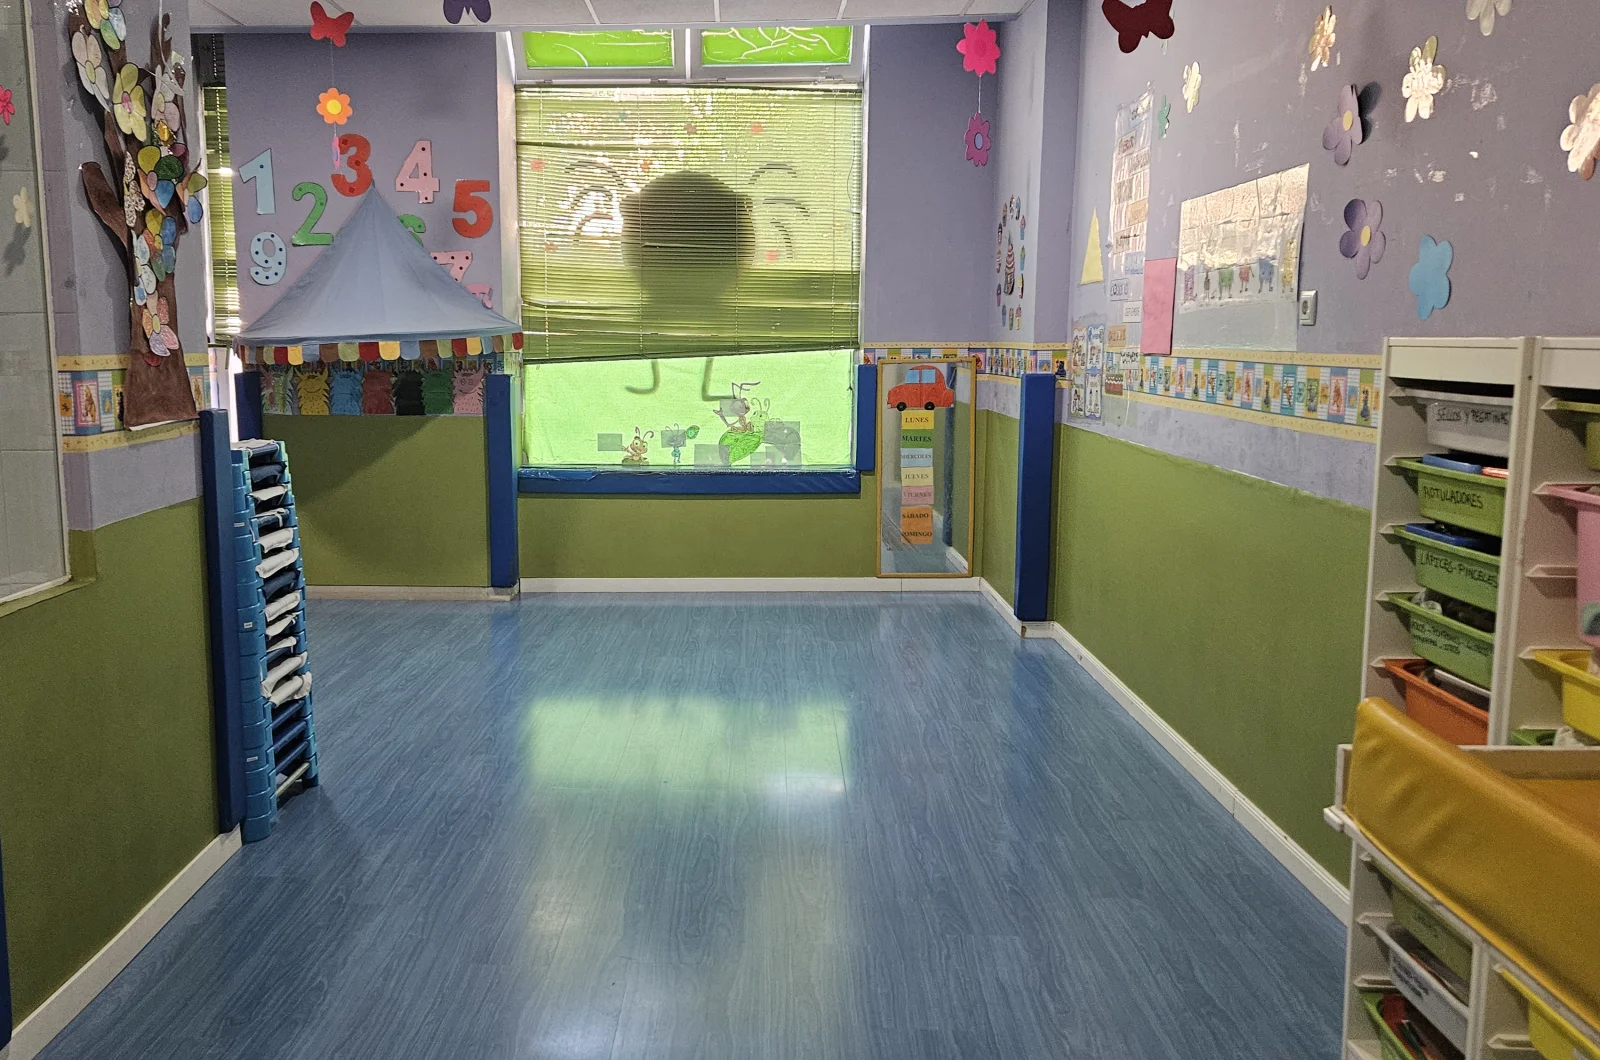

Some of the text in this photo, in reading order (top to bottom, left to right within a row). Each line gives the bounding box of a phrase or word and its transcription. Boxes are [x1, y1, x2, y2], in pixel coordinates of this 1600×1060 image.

[239, 148, 275, 215] 1
[331, 134, 373, 197] 3
[396, 140, 440, 204] 4
[292, 182, 335, 247] 2
[452, 179, 493, 238] 5
[250, 232, 287, 286] 9
[905, 416, 930, 424] LUNES
[1423, 485, 1484, 509] ROTULADORES
